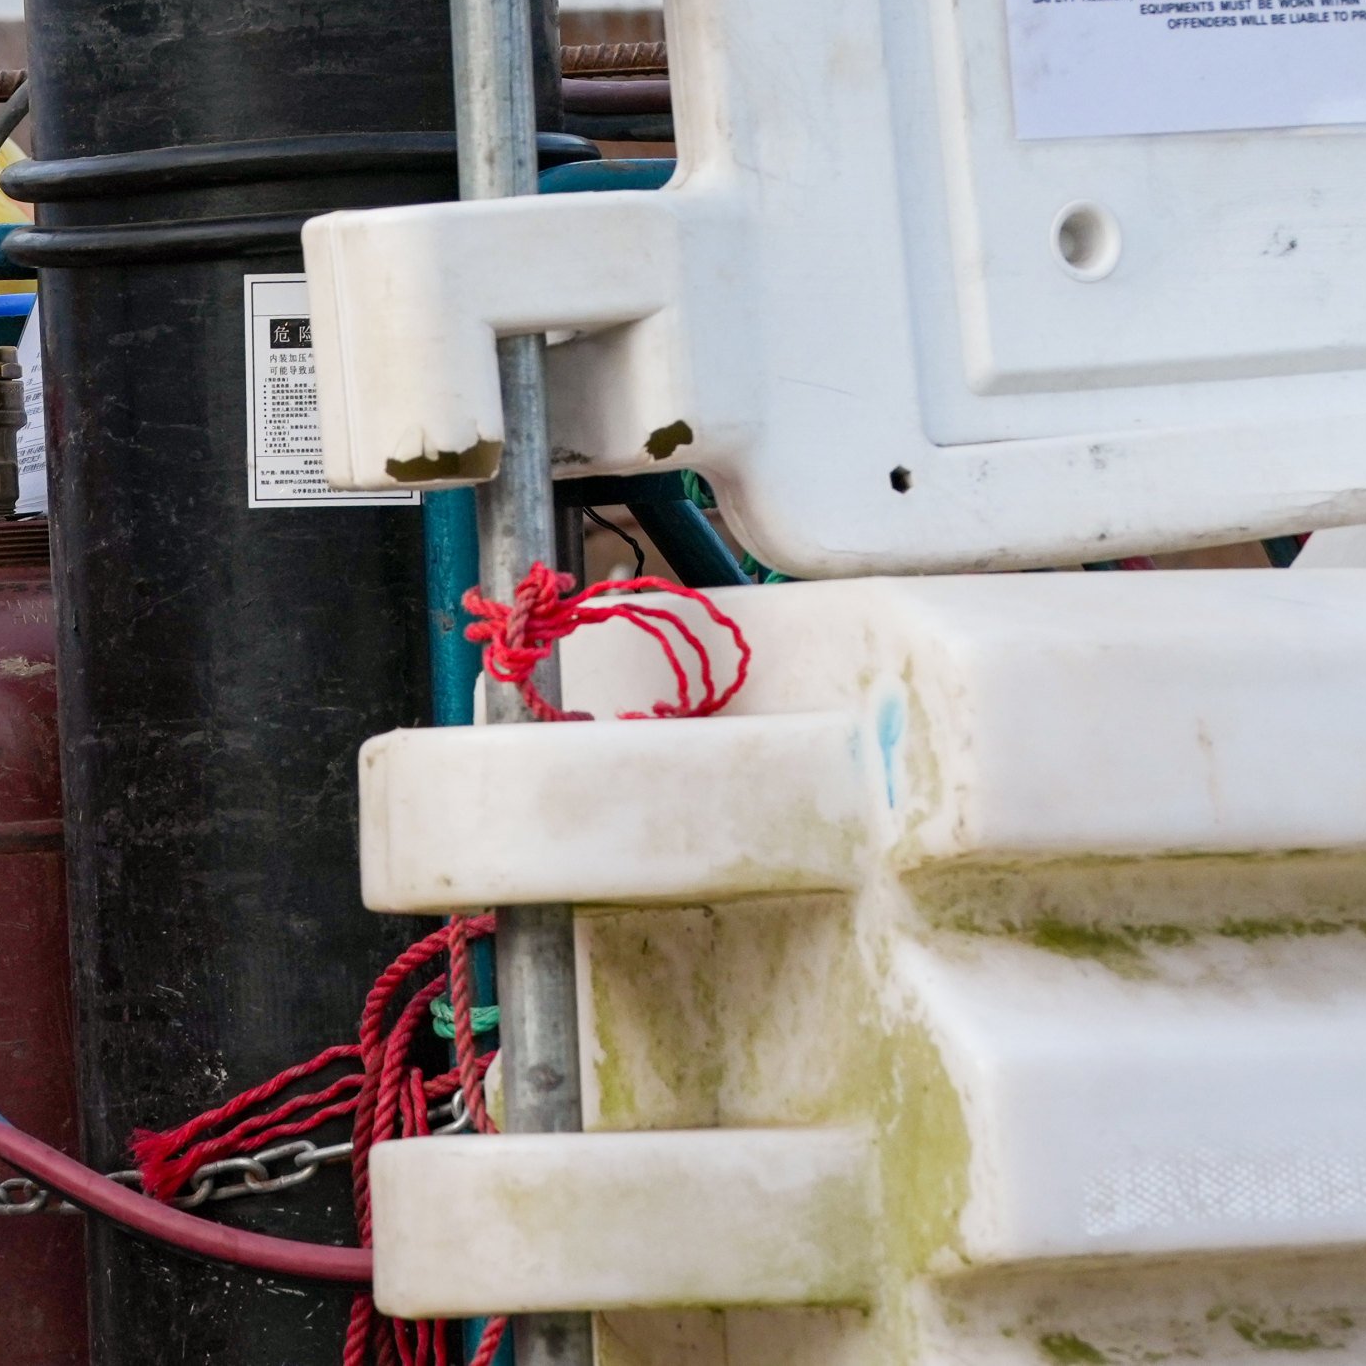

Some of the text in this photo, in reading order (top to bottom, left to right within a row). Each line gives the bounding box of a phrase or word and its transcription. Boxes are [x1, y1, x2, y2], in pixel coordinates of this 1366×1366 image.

[1140, 1, 1215, 15] EQUIPMENTS
[1220, 0, 1252, 11] MUST
[1167, 15, 1238, 29] OFFENDERS
[1241, 14, 1269, 26] WILL
[1271, 14, 1287, 25] BE
[1289, 11, 1328, 25] LIABLE
[1334, 10, 1348, 22] TO
[274, 325, 311, 343] 危险
